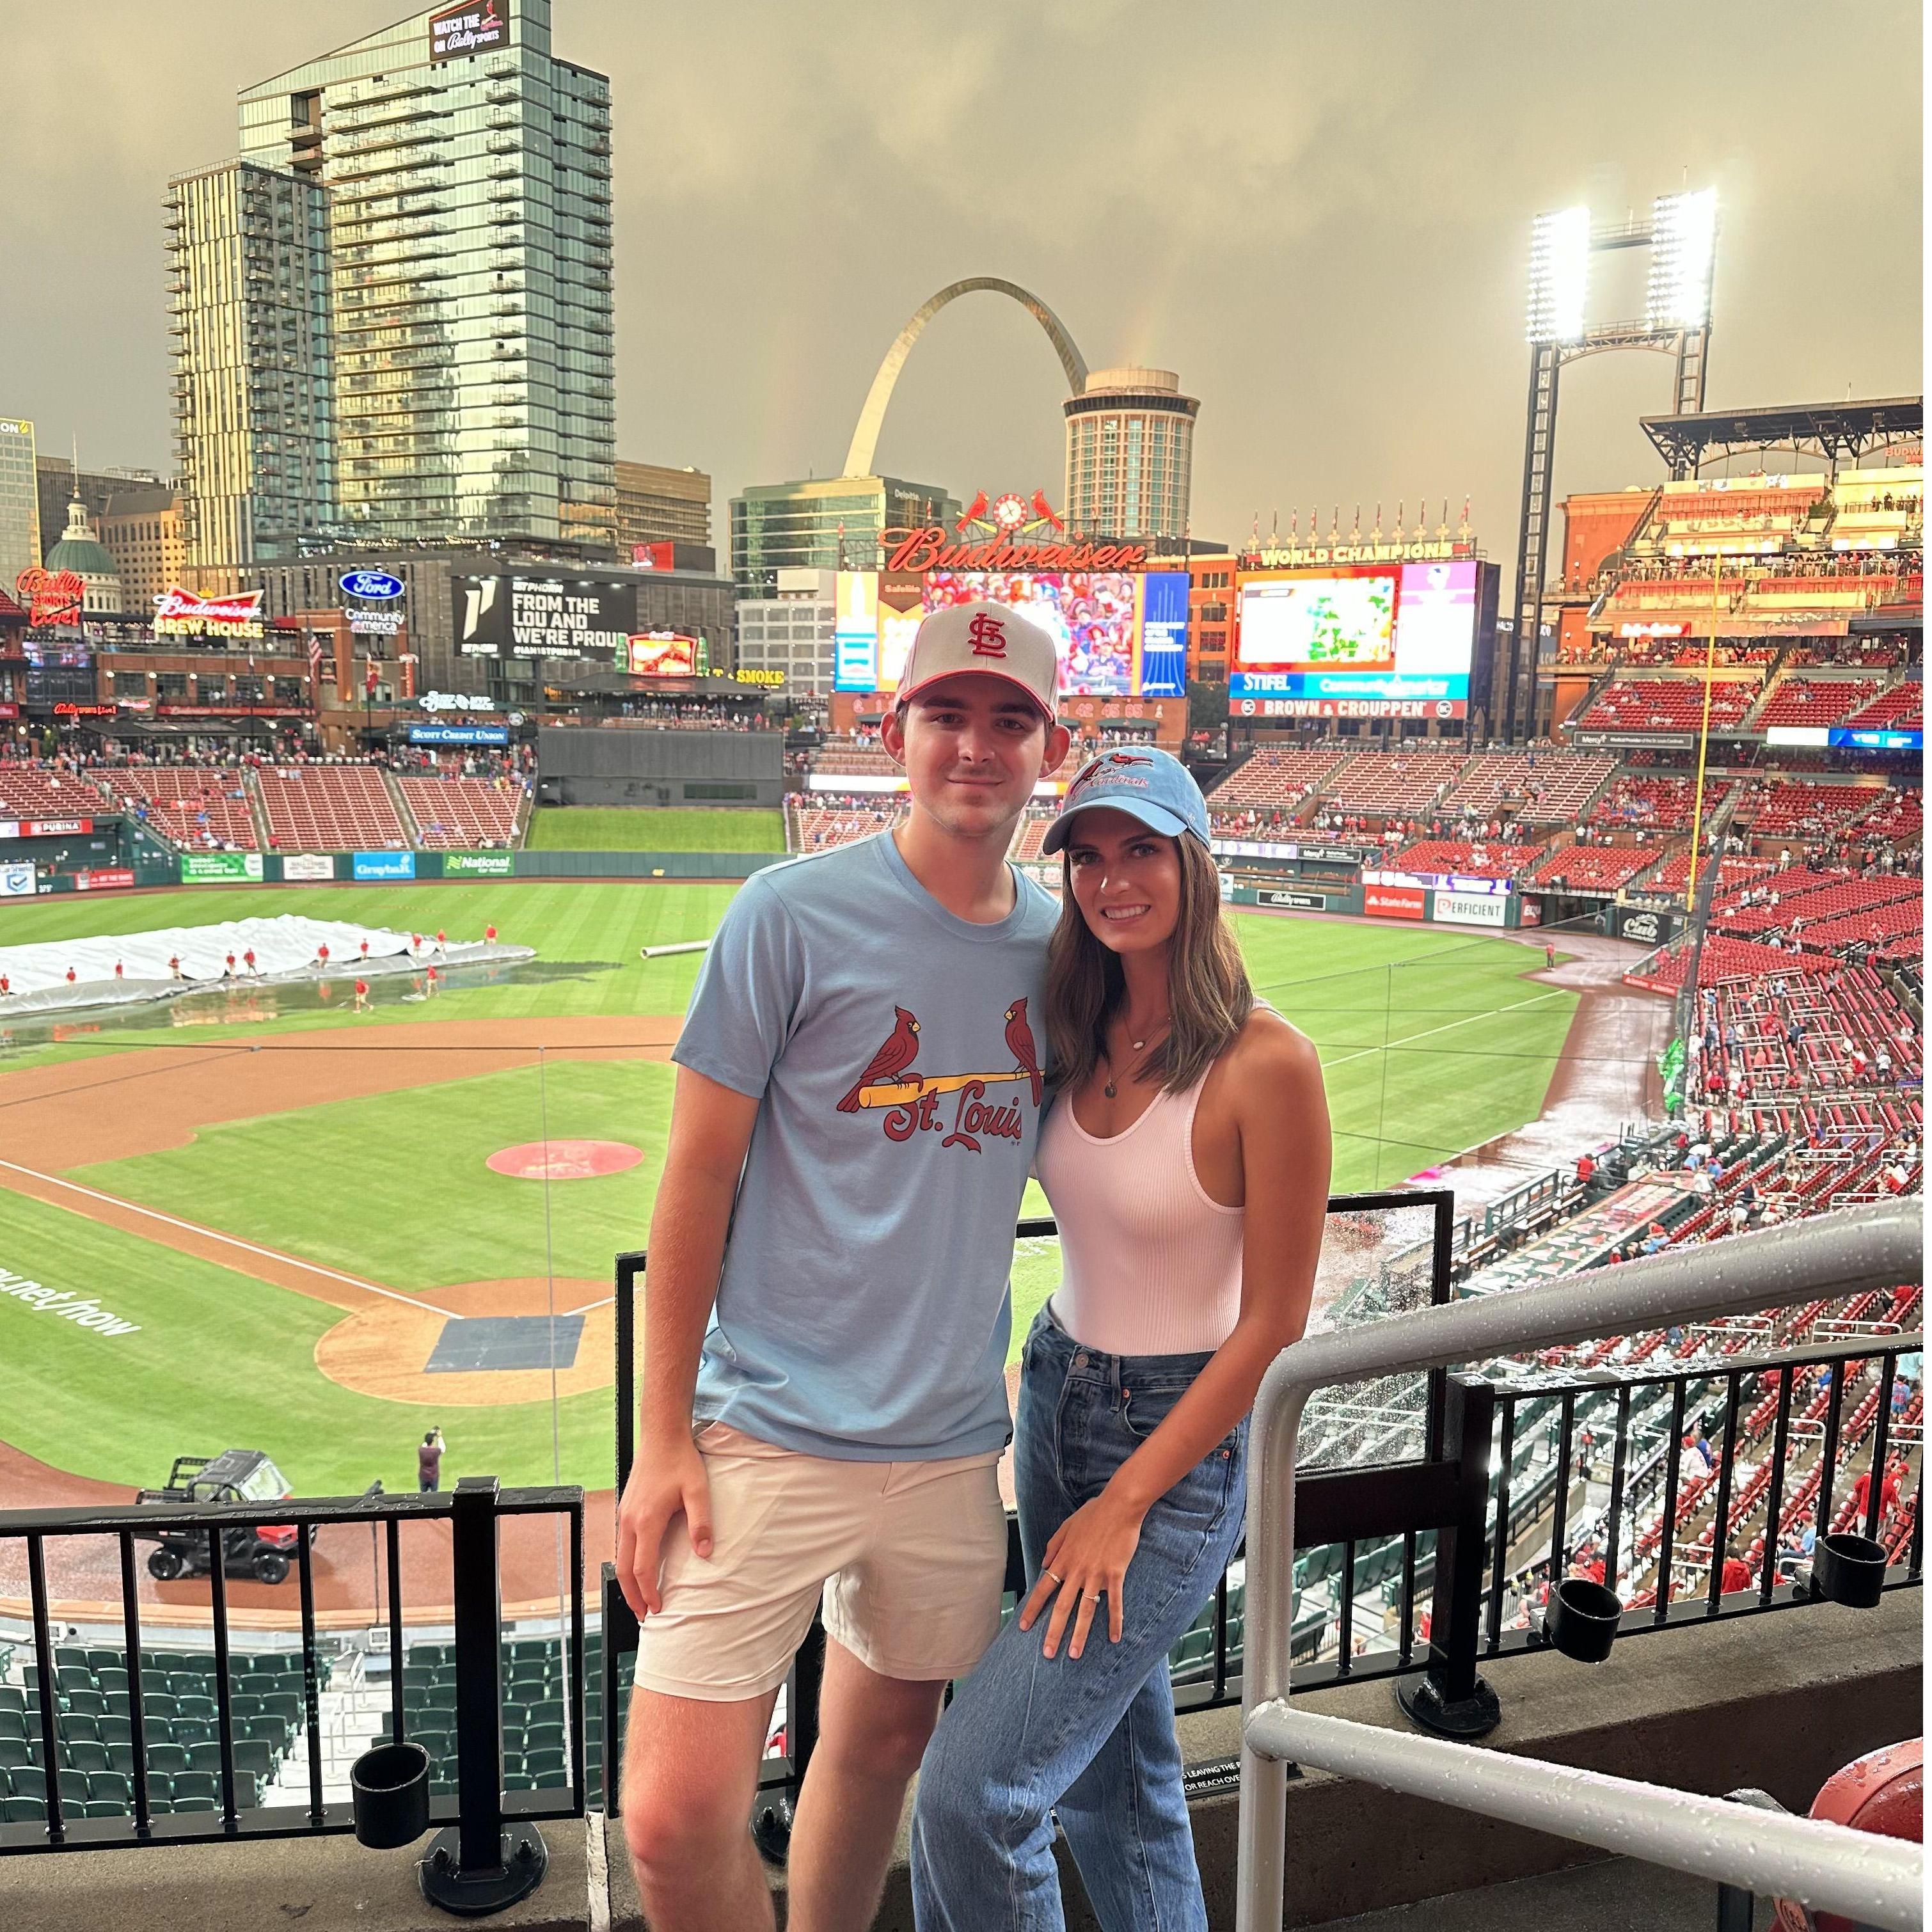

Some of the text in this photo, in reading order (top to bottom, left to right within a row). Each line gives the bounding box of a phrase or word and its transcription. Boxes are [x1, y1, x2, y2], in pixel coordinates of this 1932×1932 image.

[433, 13, 480, 35] WATCH THE
[434, 31, 499, 53] ON Bally SPORTS
[877, 527, 1149, 572] Budweiser
[1260, 542, 1453, 566] WORLD CHAMPIONS
[16, 567, 87, 601] Bally
[353, 574, 393, 594] Ford
[33, 592, 72, 607] SPORTS
[152, 594, 262, 618] Budweiser
[512, 593, 600, 615] FROM THE
[154, 618, 264, 638] BREW HOUSE
[512, 610, 588, 630] LOU AND
[512, 627, 569, 645] WE'RE
[736, 669, 785, 684] SMOKE
[1244, 673, 1292, 691] STIFEL
[1264, 701, 1424, 717] BROWN & CROUPPEN
[42, 823, 79, 832] PURINA
[461, 856, 511, 869] National
[1437, 898, 1501, 917] PERFICIENT
[883, 1072, 943, 1142] St.
[1187, 1766, 1221, 1778] LEAVING
[1219, 1762, 1237, 1771] THE
[1197, 1778, 1224, 1789] REACH
[1224, 1774, 1240, 1783] OVE
